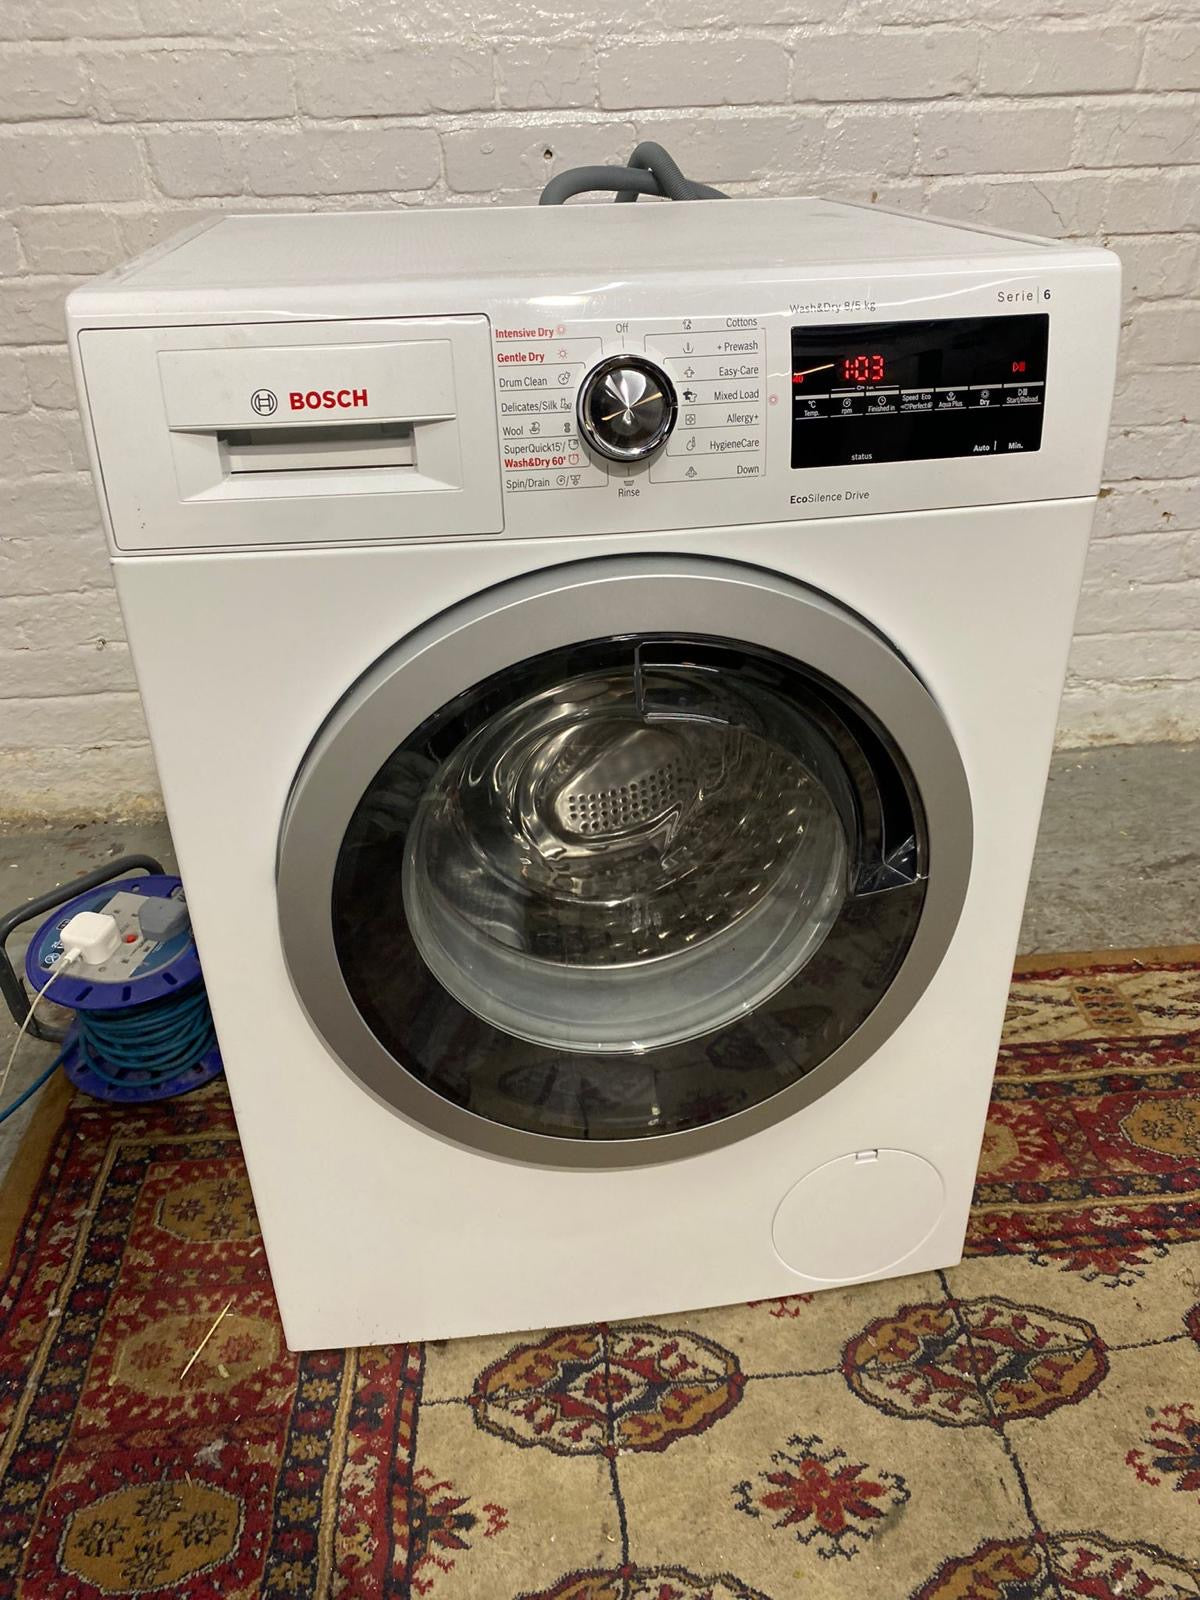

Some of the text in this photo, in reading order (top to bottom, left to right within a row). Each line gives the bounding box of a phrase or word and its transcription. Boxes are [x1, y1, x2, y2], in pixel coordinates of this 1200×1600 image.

[998, 289, 1050, 302] Serie 6
[864, 300, 876, 312] kg
[616, 323, 628, 333] Off
[726, 318, 758, 328] Cottons
[496, 328, 554, 338] Intensive Dry
[724, 340, 758, 352] Prewash
[497, 352, 544, 362] Gentle Dry
[719, 366, 758, 377] Easy-Care
[500, 377, 548, 388] Drum Clean
[289, 389, 368, 410] BOSCH
[714, 389, 759, 400] Mixed Load
[502, 401, 558, 412] Delicates/Silk
[503, 426, 524, 436] Wool
[710, 438, 760, 451] HygieneCare
[504, 458, 550, 468] Wash&Dry
[736, 466, 760, 474] Down
[506, 478, 550, 490] Spin/Drain
[618, 488, 640, 497] Rinse
[790, 492, 870, 504] EcoSilence Drive
